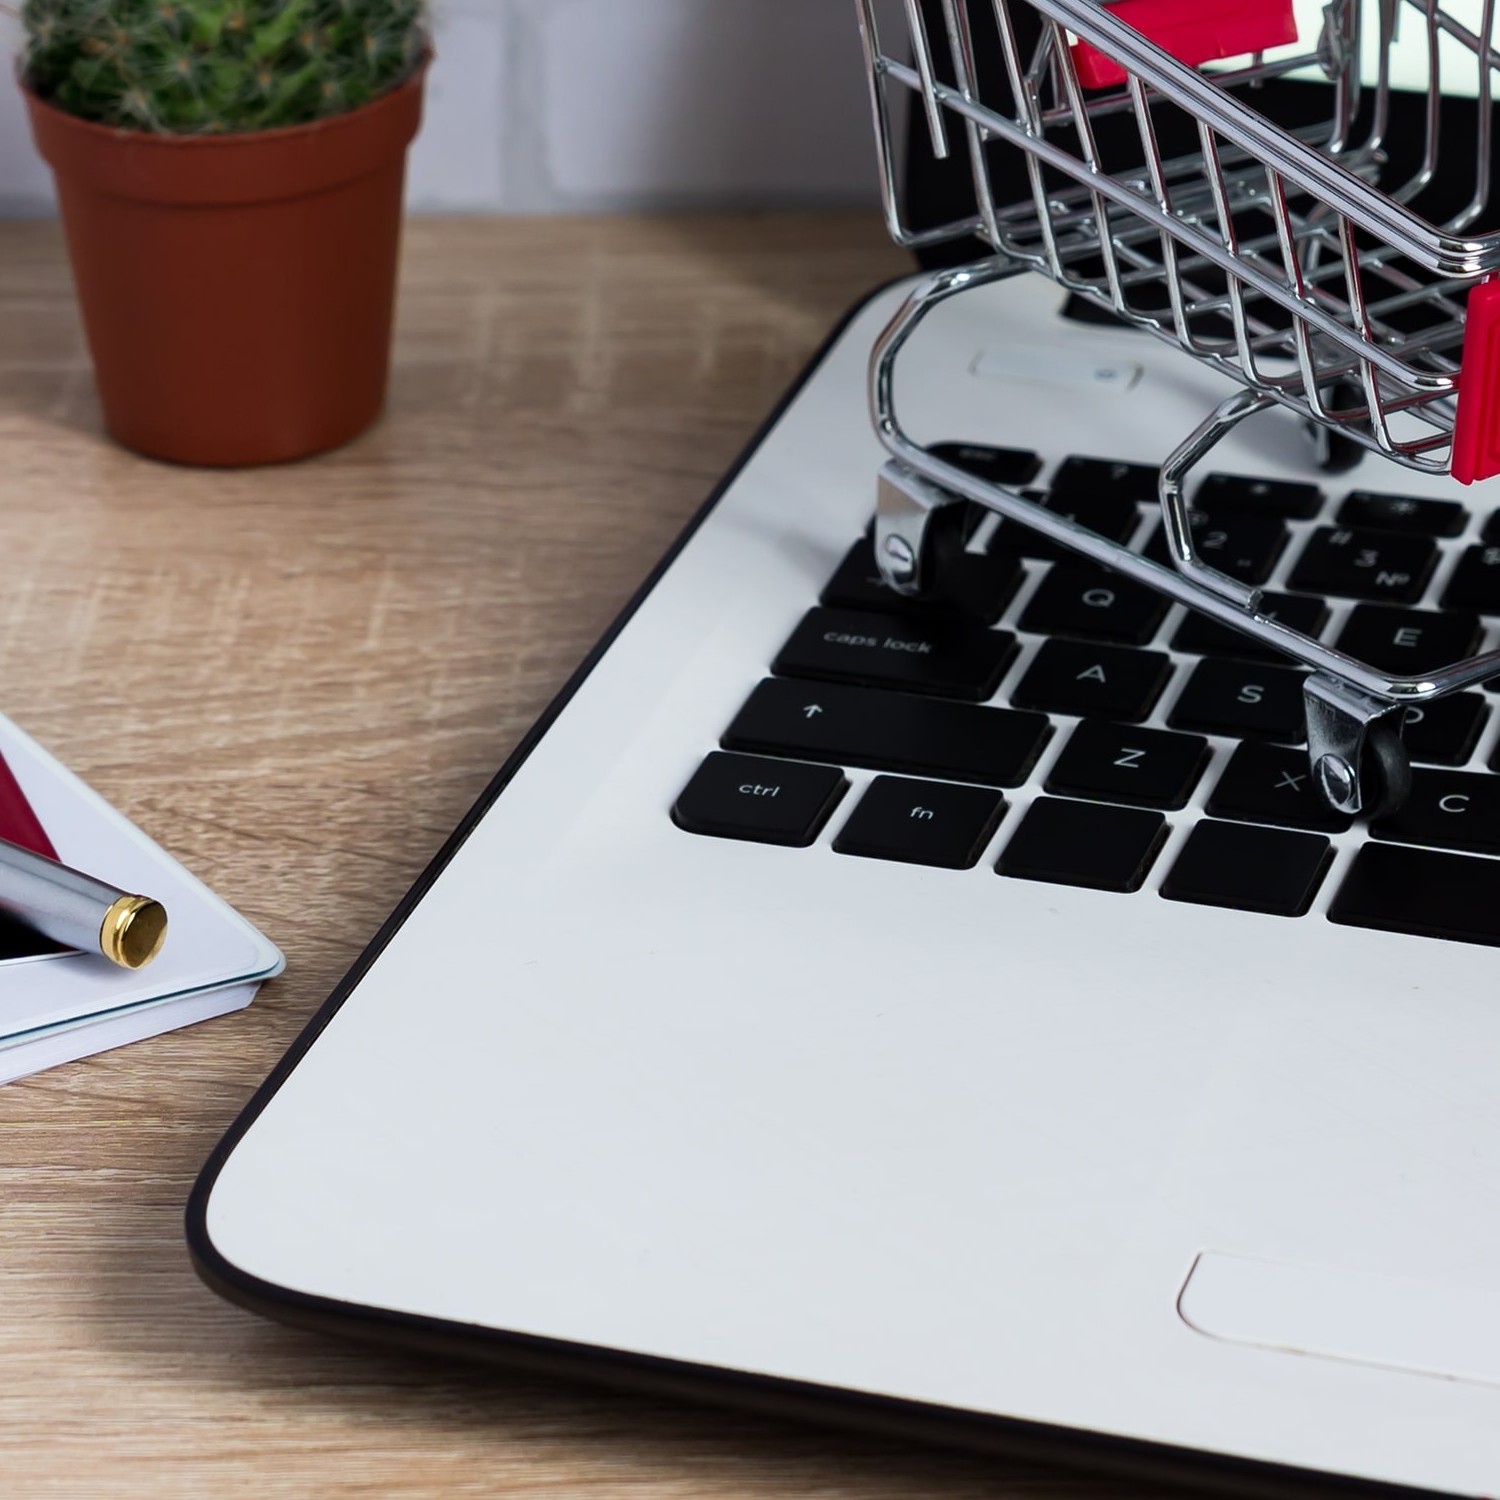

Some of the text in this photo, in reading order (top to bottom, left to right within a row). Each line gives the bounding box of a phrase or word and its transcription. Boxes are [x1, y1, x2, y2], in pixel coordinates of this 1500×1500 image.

[1202, 531, 1228, 549] 2
[1355, 549, 1378, 568] 3
[1081, 588, 1115, 607] Q
[823, 632, 931, 654] caps lock
[1393, 627, 1421, 647] E
[1076, 664, 1106, 683] A
[1237, 685, 1265, 704] S
[1113, 747, 1146, 768] Z
[738, 784, 781, 797] ctrl
[1274, 771, 1307, 792] X
[910, 806, 934, 820] fn
[1438, 794, 1470, 813] C
